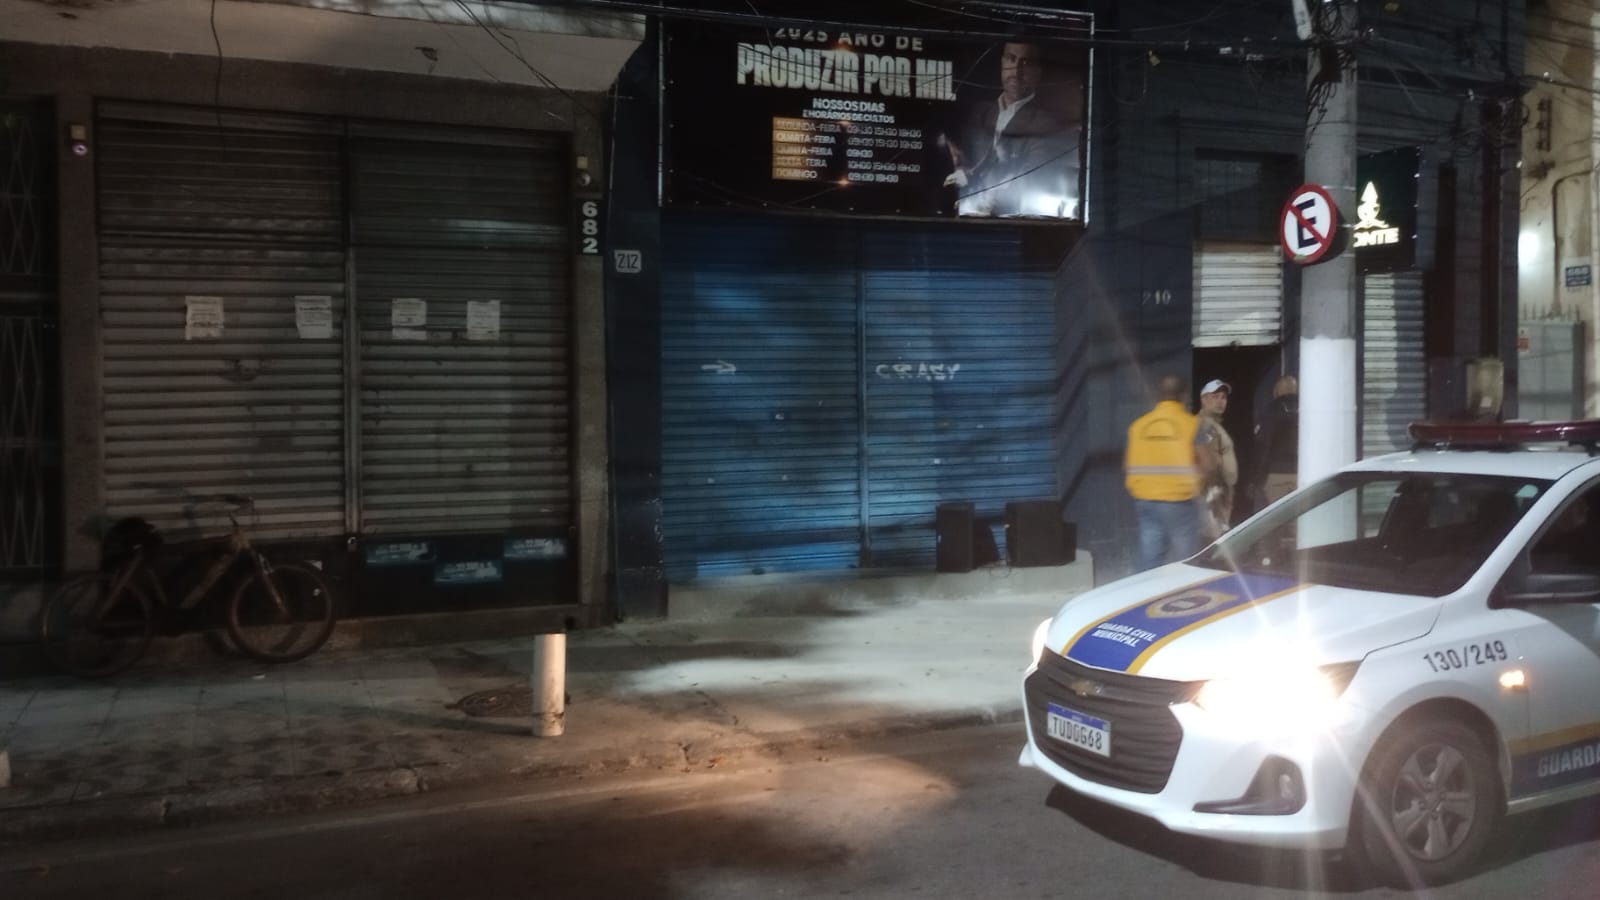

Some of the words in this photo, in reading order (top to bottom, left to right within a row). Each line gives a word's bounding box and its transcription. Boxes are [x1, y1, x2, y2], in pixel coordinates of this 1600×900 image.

[838, 31, 885, 48] ANO
[896, 36, 924, 51] DE
[737, 42, 859, 93] PRODUZIR
[864, 54, 911, 97] POR
[915, 58, 957, 101] MIL
[813, 97, 859, 112] NOSSOS
[860, 101, 886, 114] DIAS
[852, 113, 863, 121] DE
[863, 114, 895, 124] CULTOS
[775, 132, 837, 144] QUARTA-FEIRA
[776, 168, 818, 179] DOMINGO
[582, 201, 598, 254] 682
[1091, 629, 1140, 647] MUNICIPAL
[1097, 622, 1134, 634] GUARDA
[1130, 629, 1157, 642] CIVIL
[1423, 640, 1508, 673] 130/249
